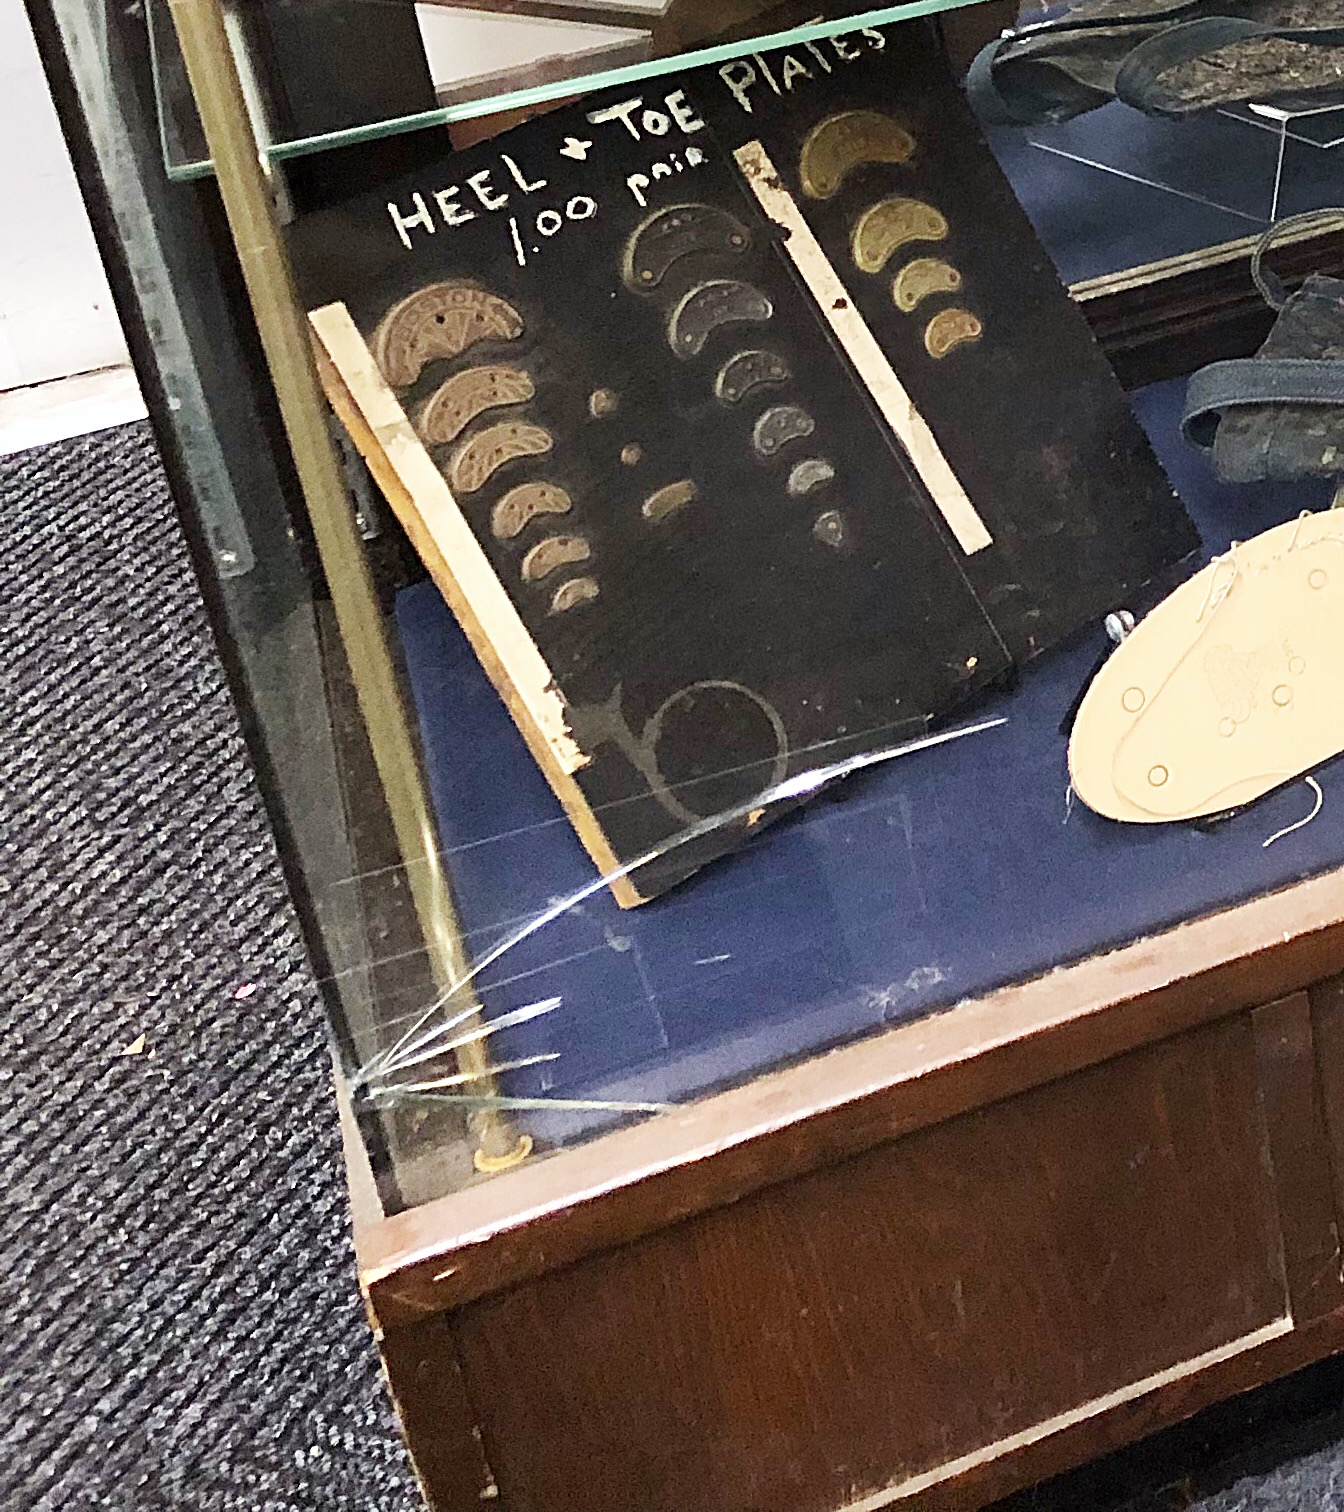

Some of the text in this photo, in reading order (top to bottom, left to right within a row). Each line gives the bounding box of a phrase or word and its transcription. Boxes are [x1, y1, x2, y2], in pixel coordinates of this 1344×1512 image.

[388, 154, 547, 249] HEEL
[588, 89, 705, 141] TOE
[508, 195, 597, 267] 1.00
